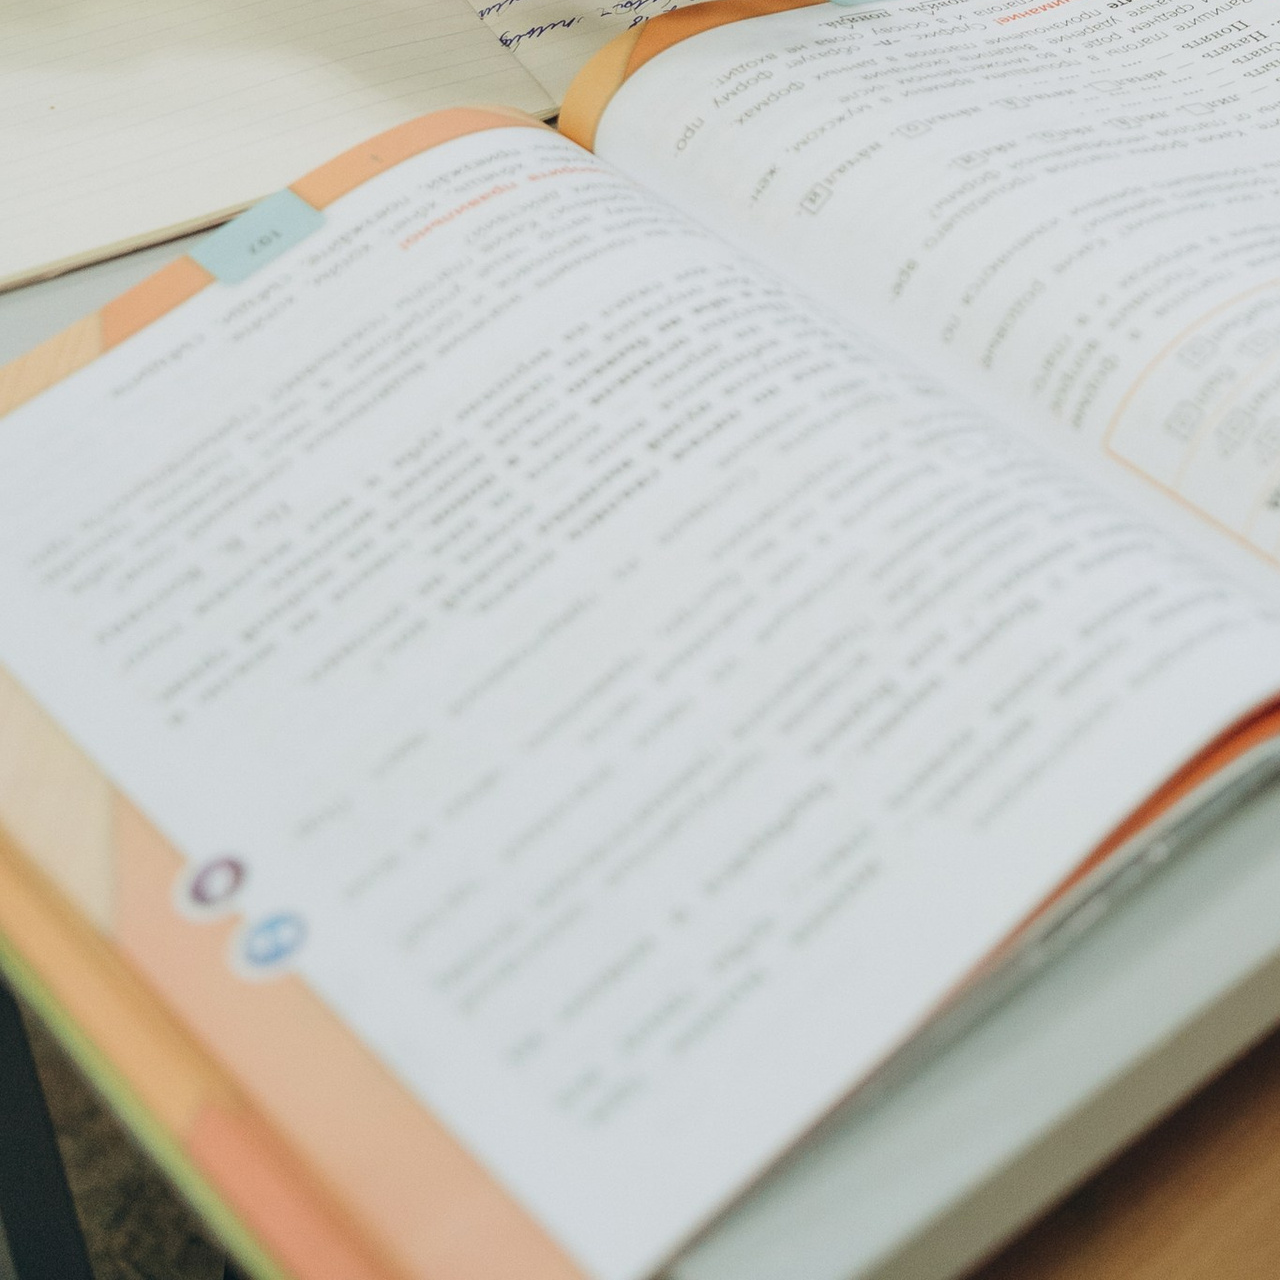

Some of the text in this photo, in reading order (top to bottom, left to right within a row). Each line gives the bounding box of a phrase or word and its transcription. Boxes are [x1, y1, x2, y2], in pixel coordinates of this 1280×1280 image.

[910, 21, 988, 42] Суффикс
[983, 8, 1104, 51] произношение
[1045, 14, 1118, 45] ударение.
[1127, 2, 1196, 35] среднем
[1081, 30, 1124, 49] роде
[1104, 30, 1170, 58] глаголы
[1181, 19, 1252, 50] Понять
[1201, 29, 1270, 59] Начать
[903, 41, 979, 65] глаголов
[712, 70, 774, 110] форму
[784, 103, 874, 154] мужском,
[398, 181, 519, 252] правильно!
